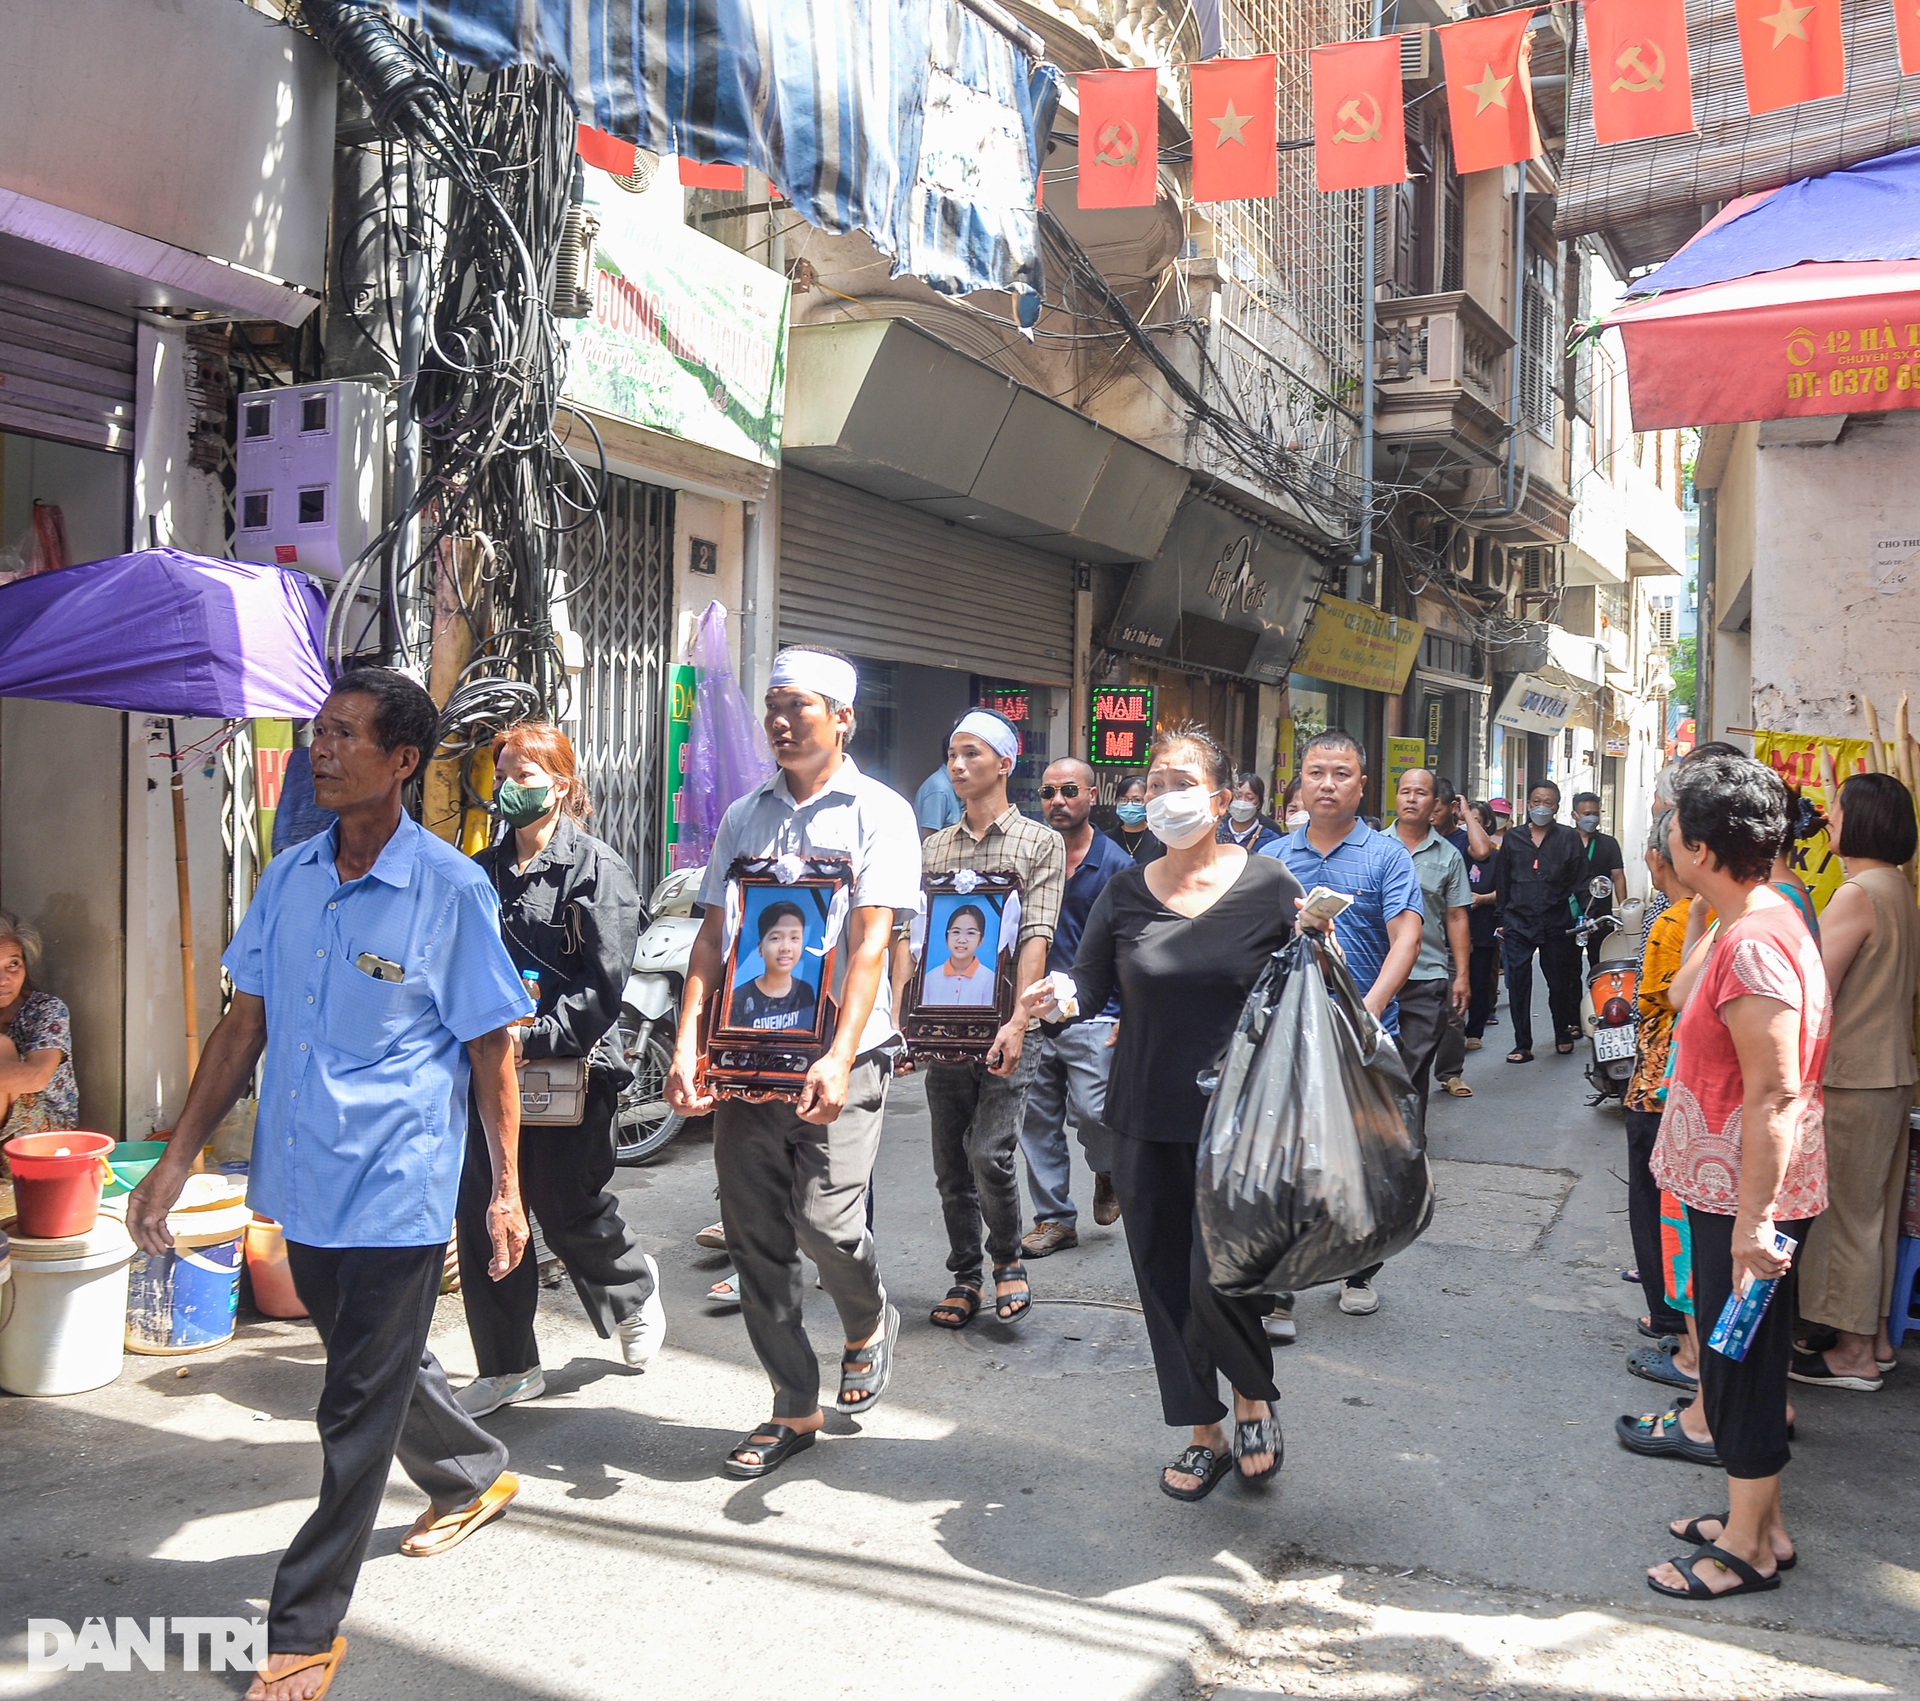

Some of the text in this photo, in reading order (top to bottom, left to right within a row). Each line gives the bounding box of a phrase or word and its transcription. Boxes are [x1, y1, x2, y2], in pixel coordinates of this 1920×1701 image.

[1783, 326, 1819, 366] Ô
[1822, 330, 1852, 354] 42
[1858, 318, 1897, 352] HÀ
[1892, 350, 1911, 360] SX
[1829, 365, 1889, 396] 0378
[1877, 540, 1900, 549] CHO
[699, 545, 709, 570] 2
[1096, 695, 1147, 720] NAIL
[1430, 704, 1439, 744] PHOTOCOPY
[1105, 731, 1134, 757] ME
[753, 1010, 800, 1029] GIVENCHY
